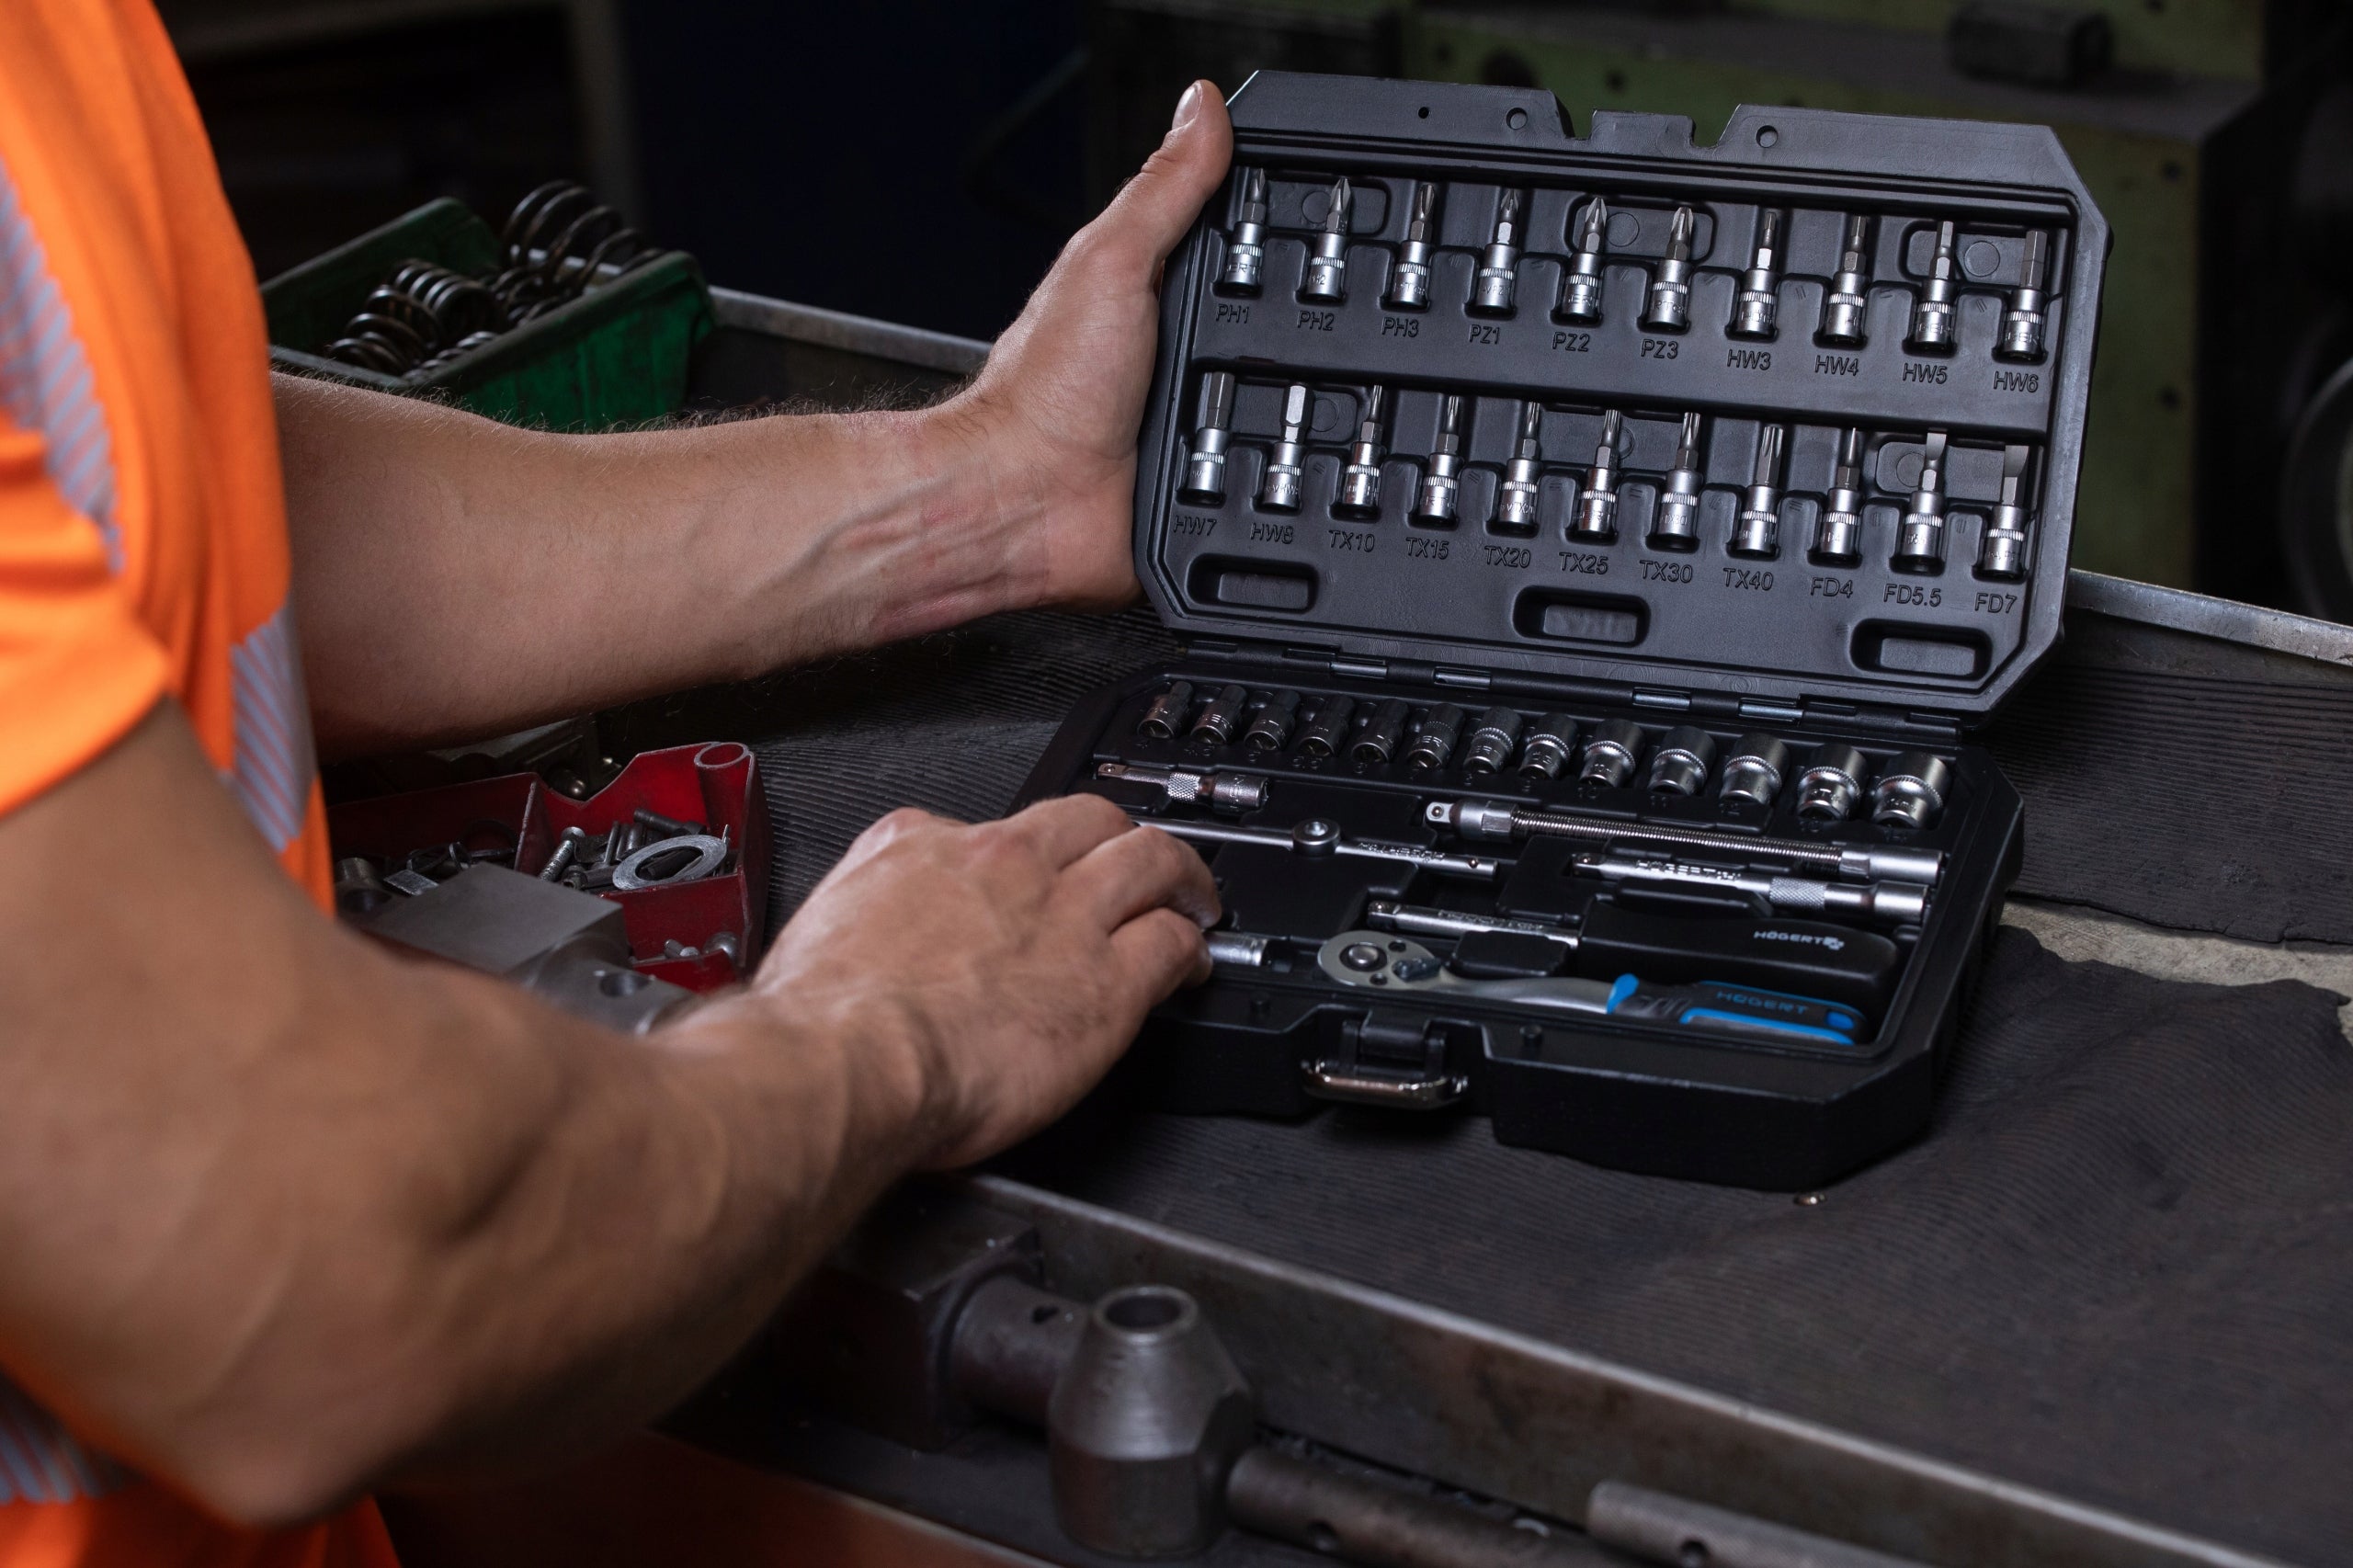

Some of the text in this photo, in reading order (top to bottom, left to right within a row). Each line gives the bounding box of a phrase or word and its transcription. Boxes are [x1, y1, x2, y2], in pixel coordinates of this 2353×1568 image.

[1215, 303, 1250, 324] PH1
[1297, 311, 1335, 332] PH2
[1381, 317, 1419, 337] PH3
[1469, 324, 1500, 345] PZ1
[1552, 331, 1590, 352] PZ2
[1641, 338, 1678, 359] PZ3
[1726, 348, 1771, 370] HW3
[1814, 355, 1859, 377] HW4
[1902, 362, 1948, 385] HW5
[1993, 370, 2040, 393] HW6
[1173, 515, 1218, 537] HW7
[1250, 522, 1294, 545] HW8
[1328, 529, 1376, 553] TX10
[1405, 537, 1449, 560] TX15
[1483, 545, 1531, 569] TX20
[1559, 551, 1608, 575] TX25
[1639, 559, 1693, 584] TX30
[1722, 567, 1774, 591] TX40
[1810, 576, 1853, 599] FD4
[1883, 584, 1941, 608] FD5.5
[1974, 592, 2018, 614] FD7
[1753, 930, 1824, 946] HÖGERT
